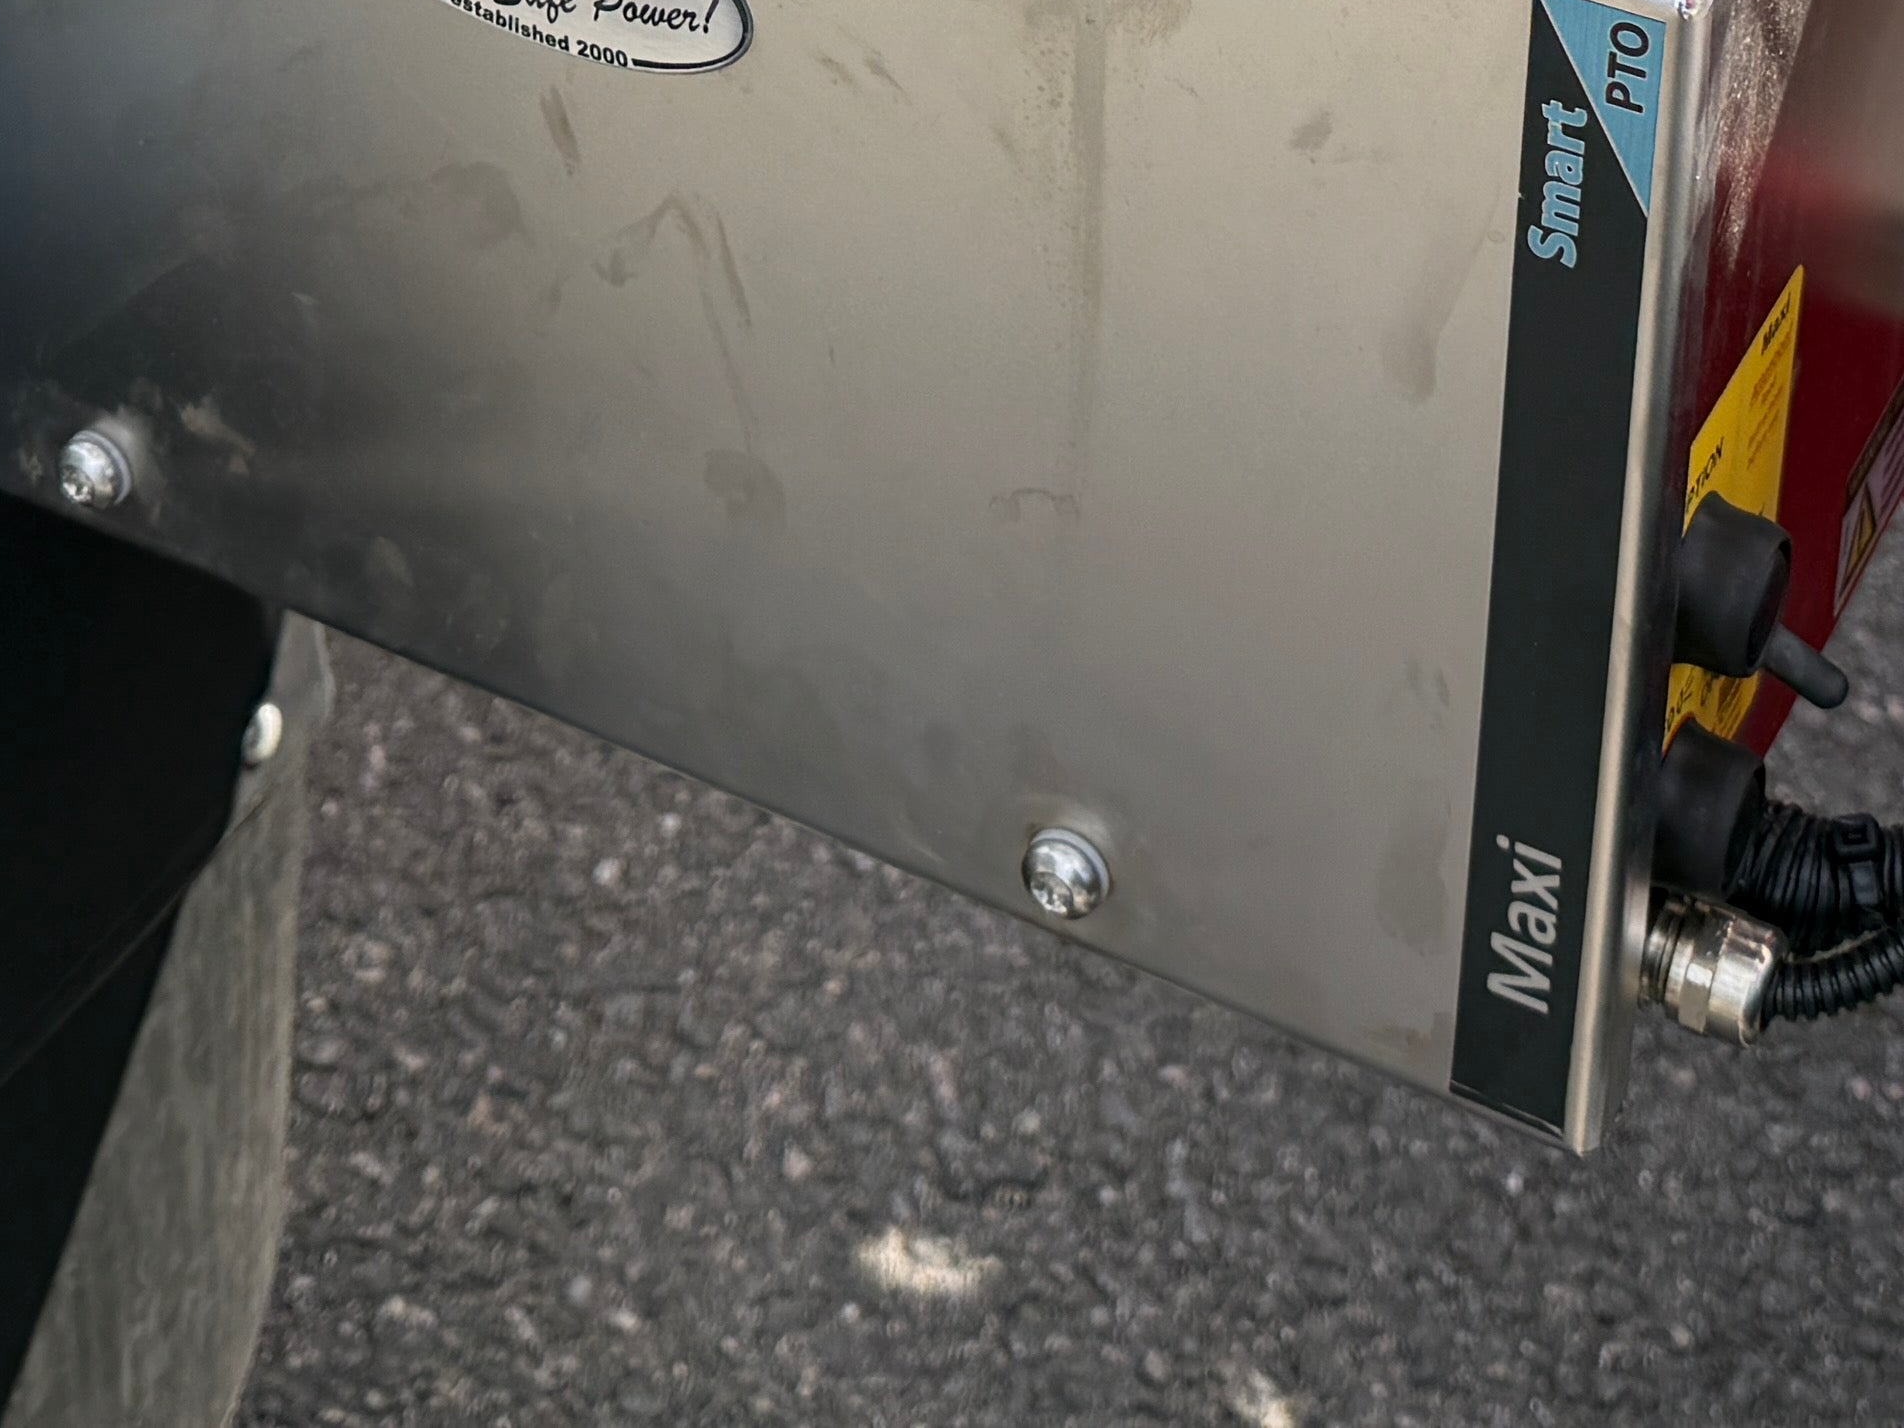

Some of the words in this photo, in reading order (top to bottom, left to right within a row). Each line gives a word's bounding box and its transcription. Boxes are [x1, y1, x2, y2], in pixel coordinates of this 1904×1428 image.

[576, 39, 629, 69] 2000
[1605, 21, 1650, 115] PTO
[1527, 99, 1589, 269] Smart
[1487, 834, 1562, 1015] Maxi
